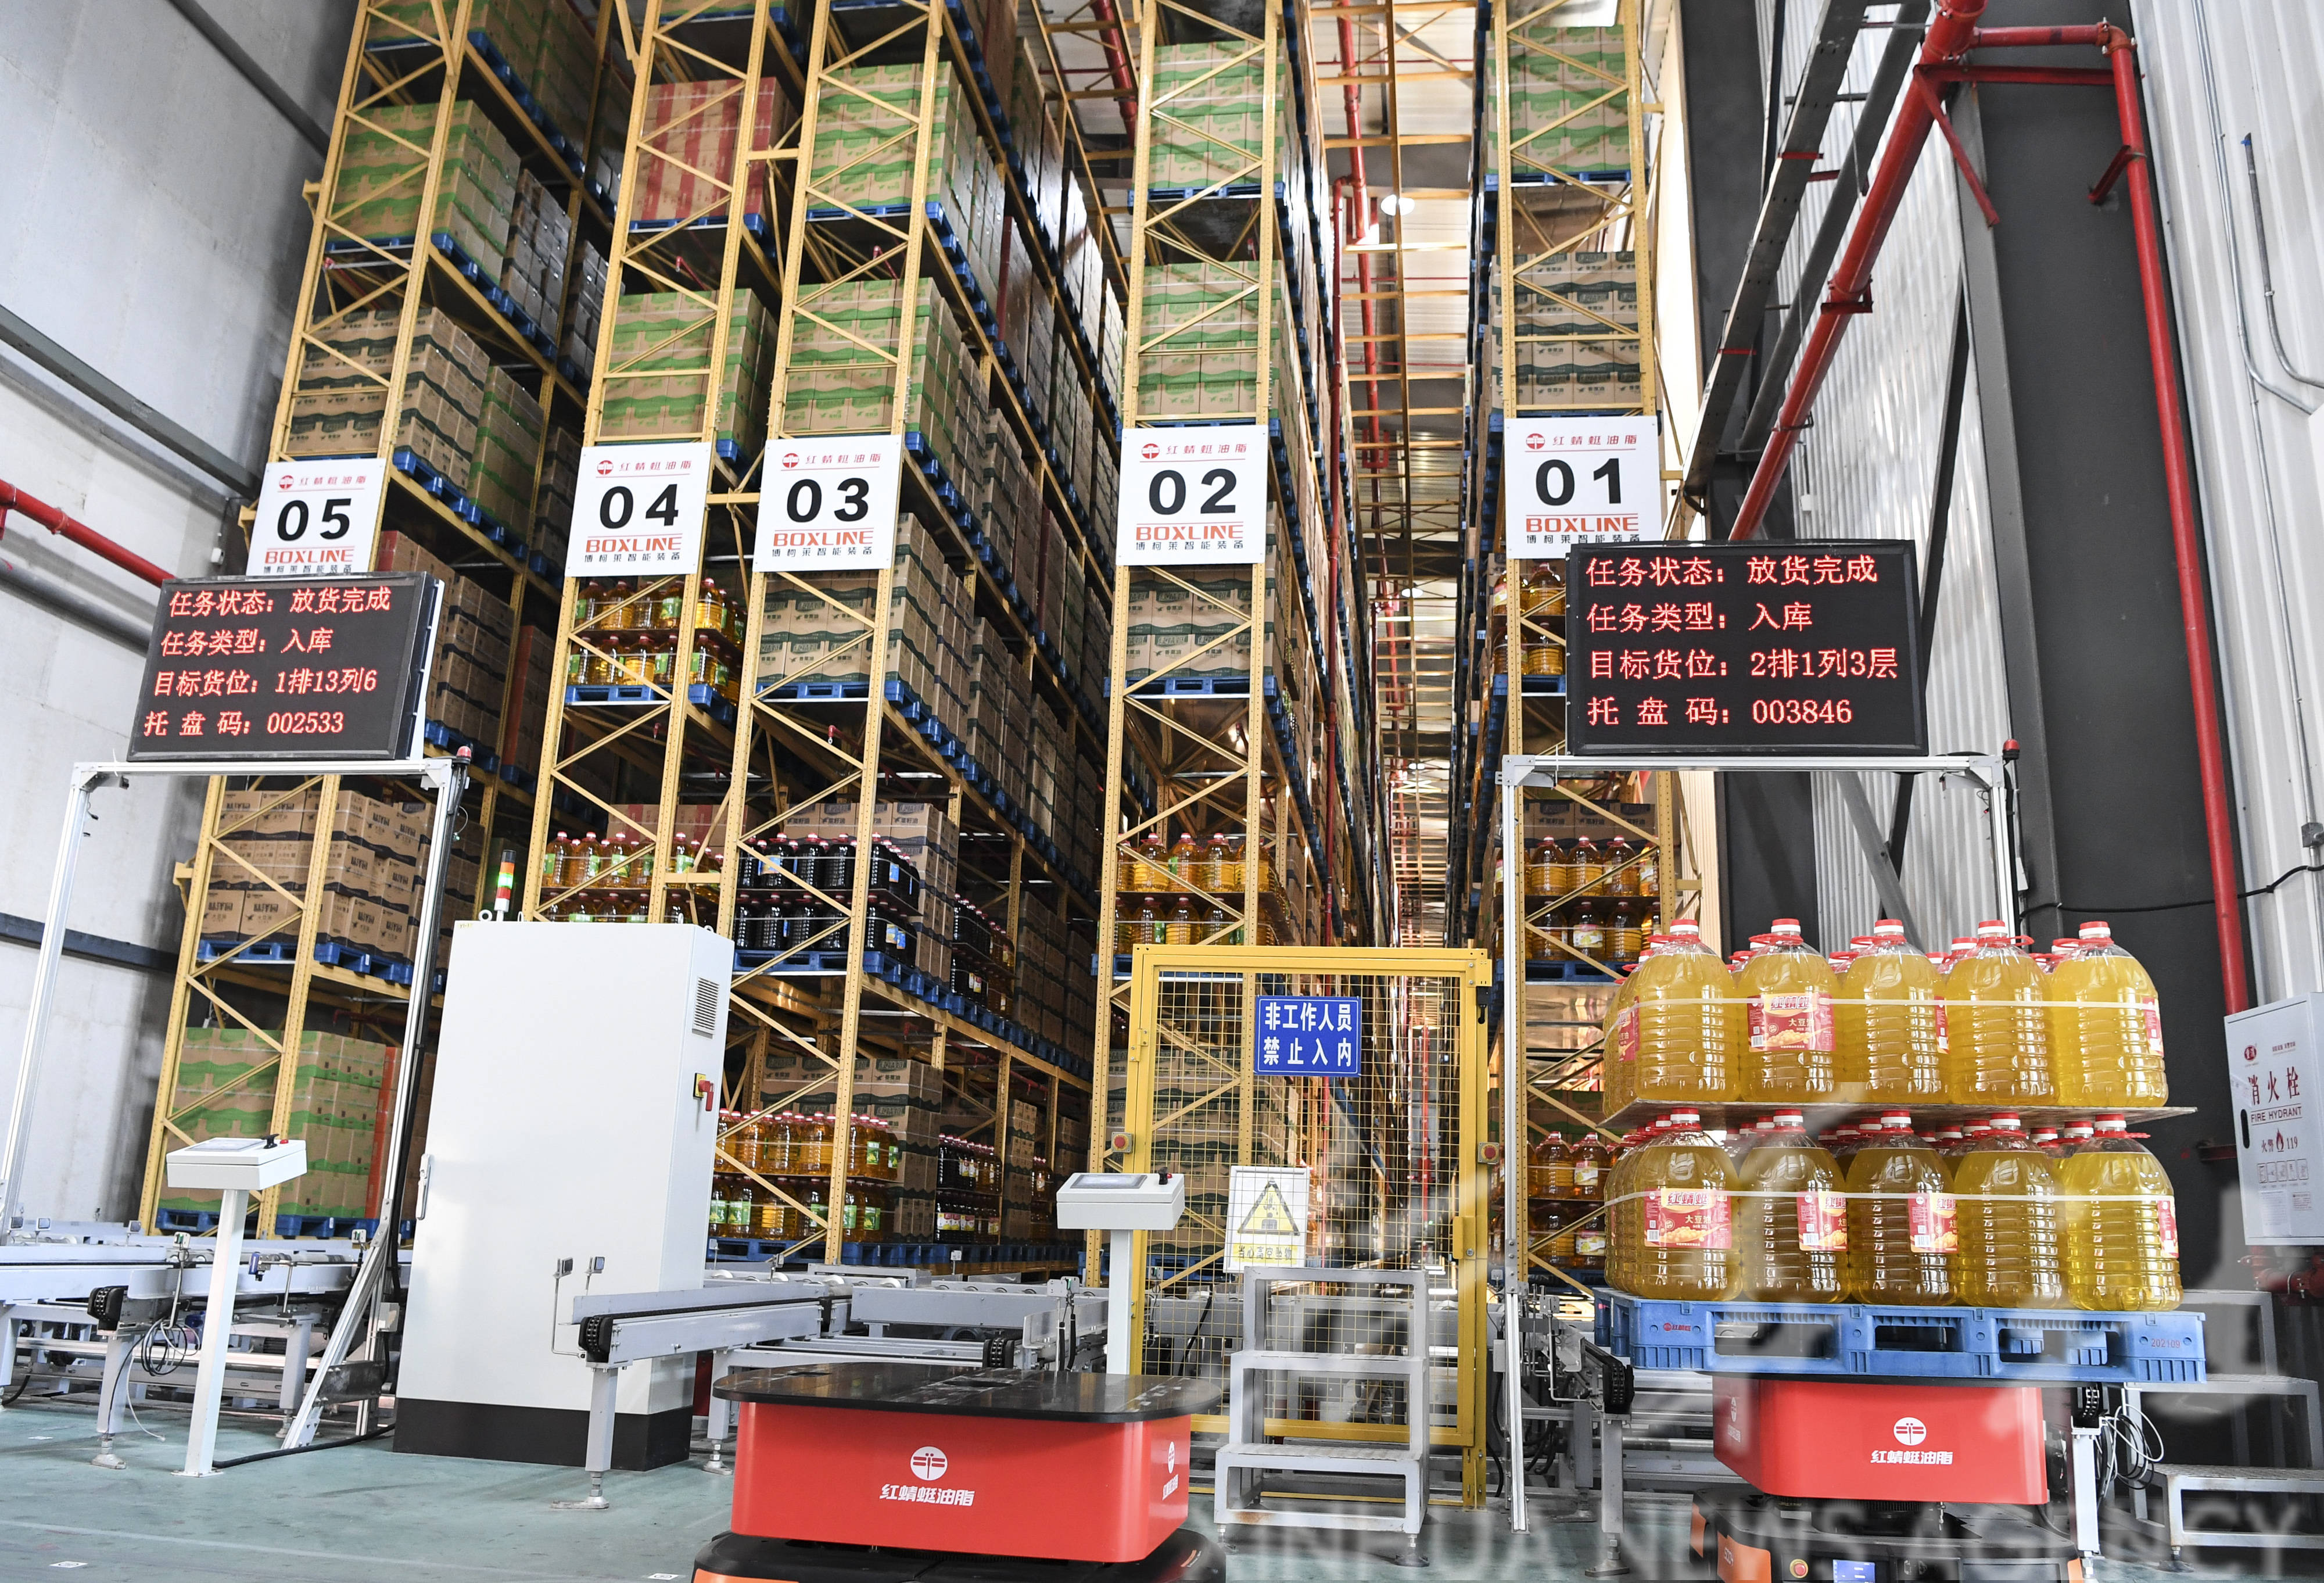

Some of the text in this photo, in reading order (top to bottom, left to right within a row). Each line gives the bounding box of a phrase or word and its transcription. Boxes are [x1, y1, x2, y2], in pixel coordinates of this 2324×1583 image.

[1552, 435, 1637, 446] 红蜻蜓油脂
[1167, 443, 1247, 455] 红蜻蜓油脂
[619, 460, 691, 471] 红蜻蜓油脂
[805, 453, 881, 464] 红蜻蜓油脂
[1536, 458, 1621, 506] 01
[1149, 468, 1236, 515] 02
[600, 484, 679, 529] 04
[787, 478, 869, 522] 03
[277, 498, 352, 541] 05
[1526, 517, 1638, 532] BOXLINE
[773, 531, 873, 546] BOXLINE
[1136, 525, 1243, 540] BOXLINE
[586, 537, 682, 553] BOXLINE
[772, 546, 873, 557] 博柯莱智能装备
[1136, 540, 1243, 550] 博柯莱智能装备
[265, 549, 354, 564] BOXLINE
[584, 553, 681, 563] 博柯莱智能装备
[1264, 1001, 1353, 1032] 非工作人员
[1263, 1037, 1352, 1067] 禁止入内
[2247, 1066, 2300, 1105] 消火栓
[2251, 1106, 2302, 1123] FIRE HYDRANT
[2286, 1136, 2298, 1150] 119
[1668, 1192, 1709, 1206] 红蜻蜓
[1685, 1215, 1712, 1224] 大豆油
[2151, 1338, 2180, 1349] 202109
[1870, 1450, 1953, 1465] 红蜻蜓油脂
[879, 1484, 975, 1506] 红蜻蜓油脂
